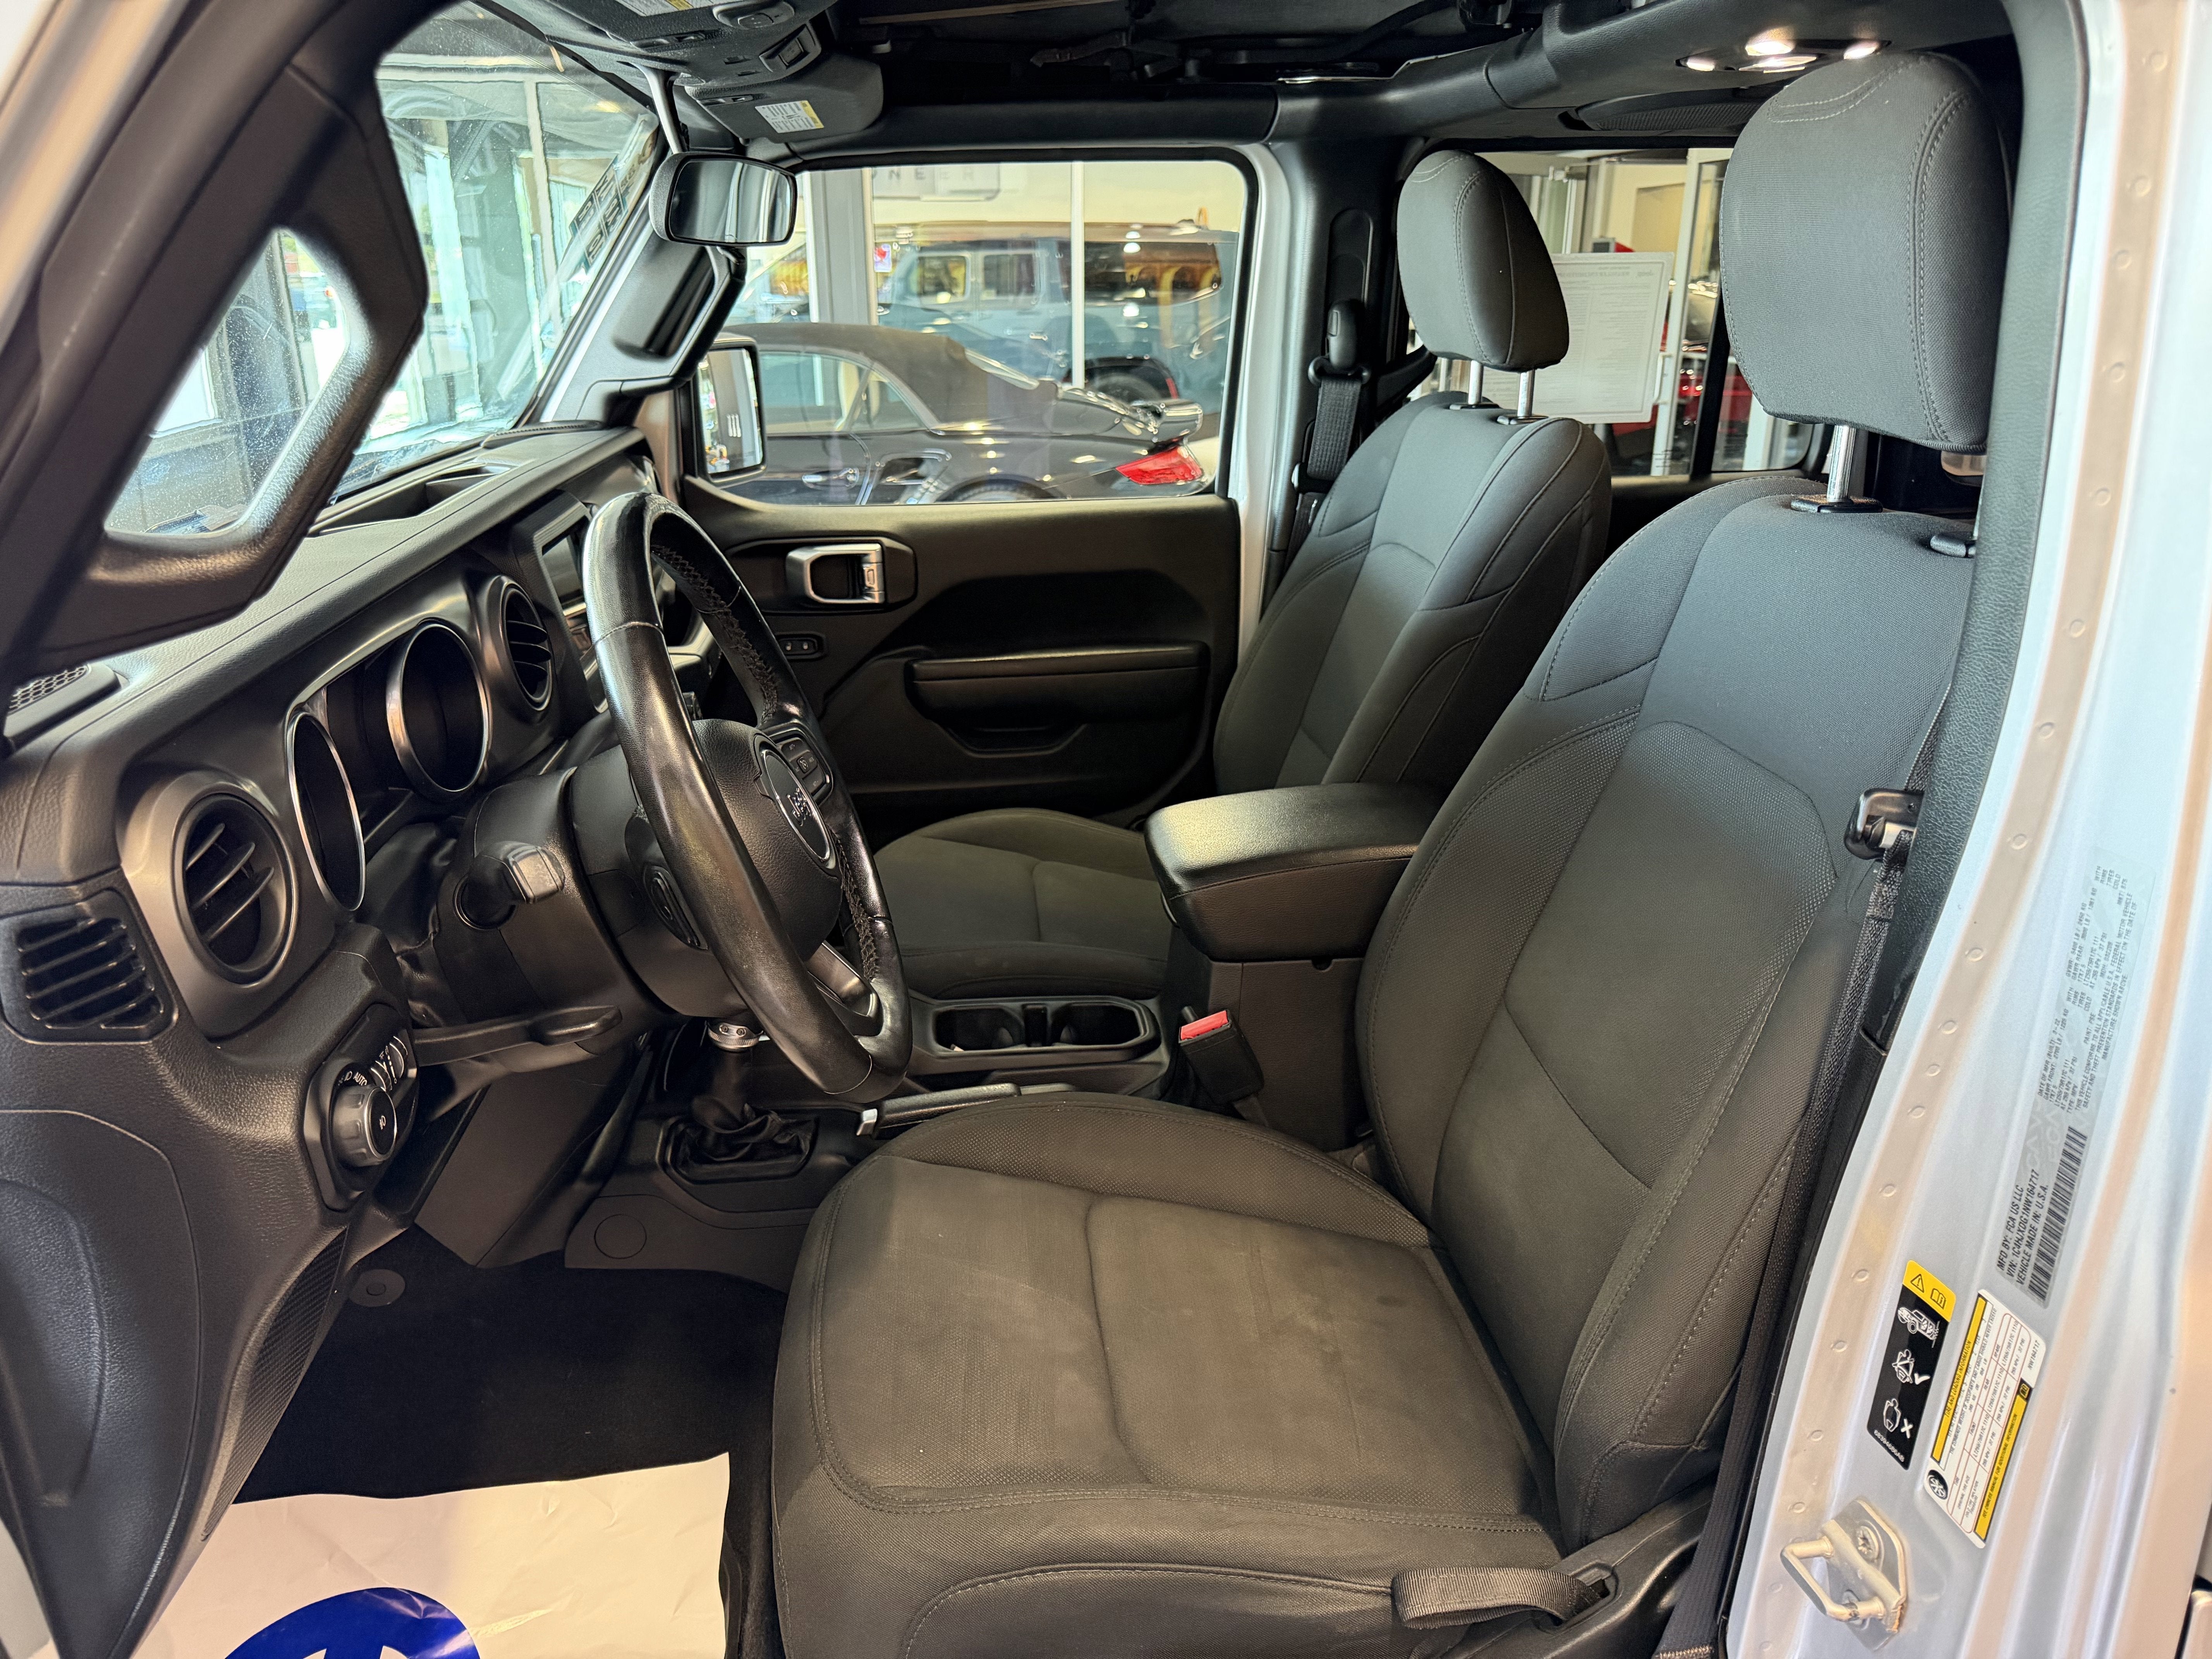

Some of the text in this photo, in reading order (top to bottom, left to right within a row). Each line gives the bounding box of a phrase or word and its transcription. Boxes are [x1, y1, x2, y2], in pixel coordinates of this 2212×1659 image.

[2106, 869, 2114, 886] TIRES
[2122, 893, 2132, 917] VEHICLE
[2131, 901, 2137, 910] OF
[2117, 918, 2126, 939] MOTOR
[2127, 911, 2136, 927] DATE
[2089, 981, 2095, 989] AT
[2113, 873, 2121, 890] COLD
[2110, 941, 2121, 966] FEDERAL
[2121, 941, 2128, 950] ON
[2071, 962, 2080, 980] GAWR
[2116, 951, 2126, 973] EFFECT
[2066, 987, 2074, 1002] WITH
[2078, 991, 2086, 1008] TIRES
[2097, 987, 2110, 1022] APPLICABLE
[2105, 982, 2118, 1017] STANDARDS
[2092, 1034, 2099, 1042] TO
[2096, 1018, 2109, 1053] PREVENTION
[2101, 1018, 2117, 1060] MANUFACTURE
[2112, 995, 2122, 1017] SHOWN
[2060, 1102, 2066, 1110] AT
[2084, 996, 2092, 1012] COLD
[2084, 1043, 2096, 1074] CONFORMS
[2091, 1054, 2099, 1072] THEFT
[353, 1072, 368, 1086] AUTO
[2041, 1073, 2047, 1081] OF
[2078, 1074, 2088, 1097] VEHICLE
[2075, 1098, 2083, 1111] THIS
[2082, 1086, 2092, 1108] SAFETY
[1997, 1185, 2024, 1271] MFD BY: FCA US LLC
[2006, 1170, 2039, 1277] VIN: 1C4HJXDG1NW164717
[2016, 1185, 2048, 1285] VEHICLE MADE IN: U.S.A.
[1957, 1339, 1971, 1374] INFORMATION
